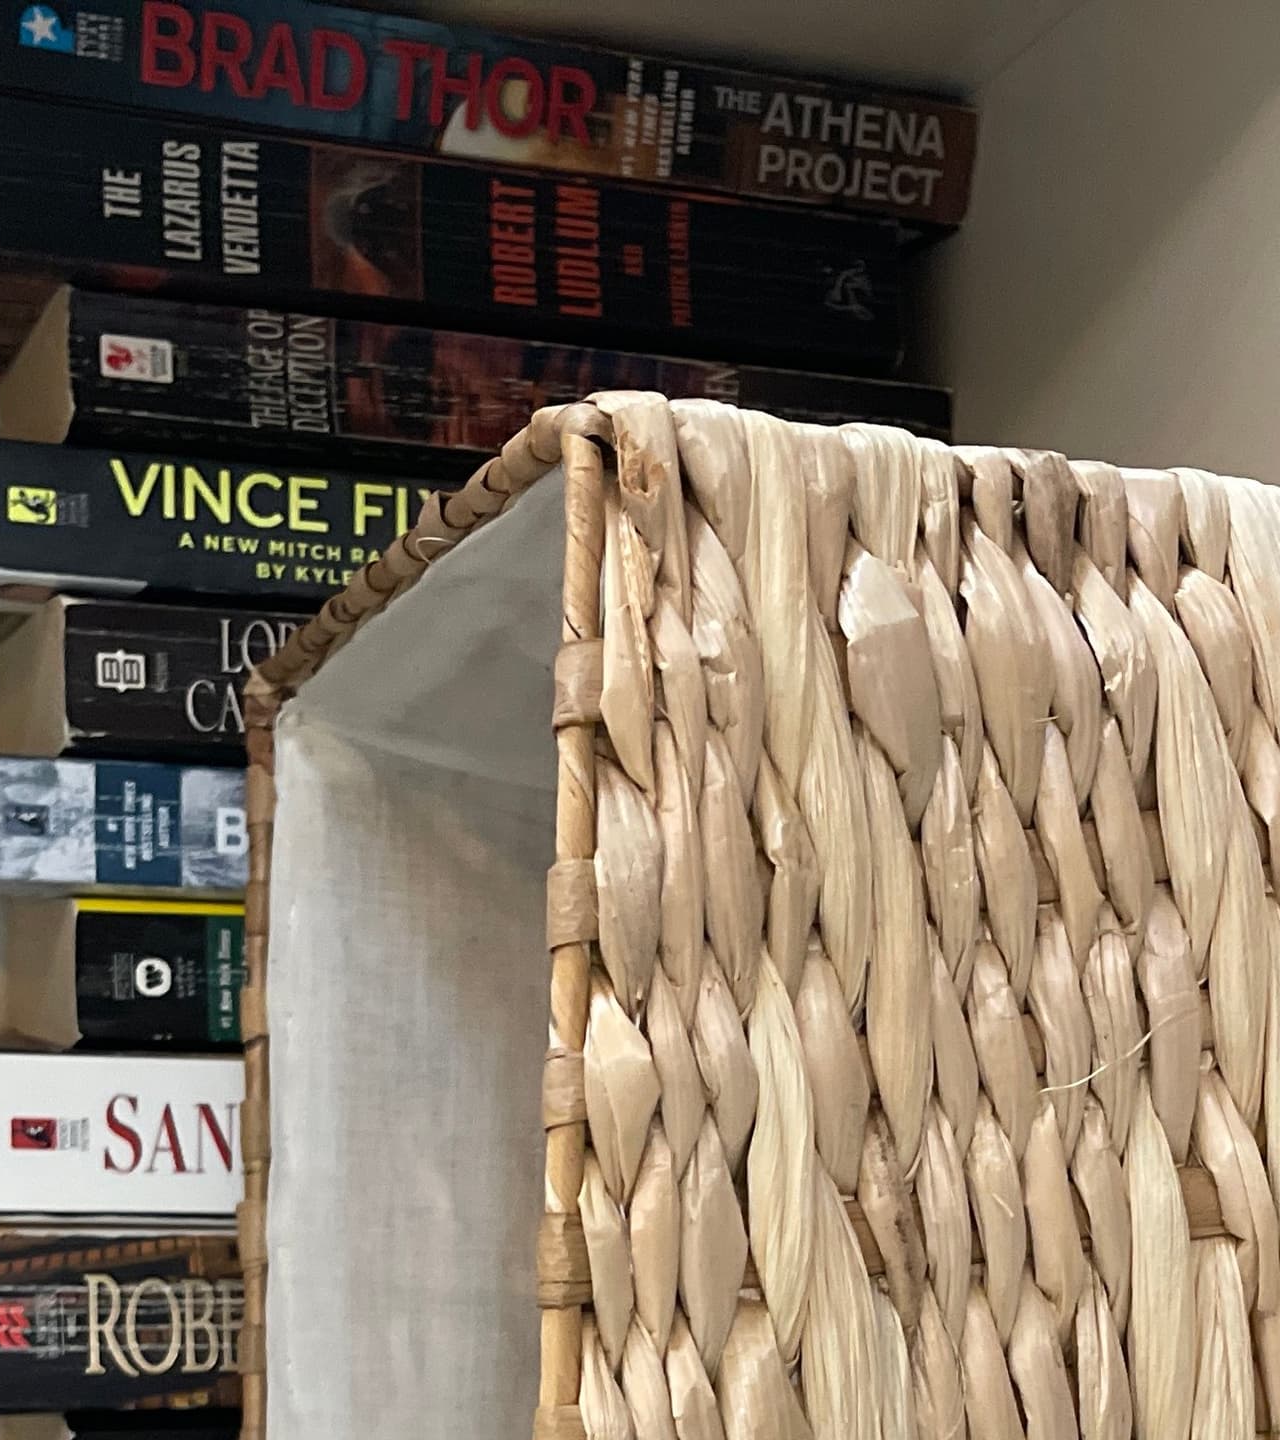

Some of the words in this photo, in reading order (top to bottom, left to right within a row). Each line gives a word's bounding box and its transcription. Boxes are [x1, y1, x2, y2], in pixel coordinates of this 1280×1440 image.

[140, 1, 368, 112] BRAD
[383, 38, 597, 147] THOR
[713, 86, 762, 114] THE
[760, 91, 945, 159] ATHENA
[103, 167, 143, 219] THE
[162, 139, 203, 262] LAZARUS
[222, 141, 261, 275] VENDETTA
[758, 144, 942, 206] PROJECT
[490, 180, 537, 306] ROBERT
[555, 184, 603, 317] LUDLUM
[288, 311, 332, 433] DECEPTION
[249, 395, 287, 428] THE
[109, 459, 329, 533] VINCE
[178, 532, 195, 549] A
[205, 534, 259, 555] NEW
[269, 540, 342, 562] MITCH
[351, 547, 383, 563] RA
[255, 562, 286, 581] BY
[186, 679, 246, 733] CA
[105, 1094, 238, 1174] SAN
